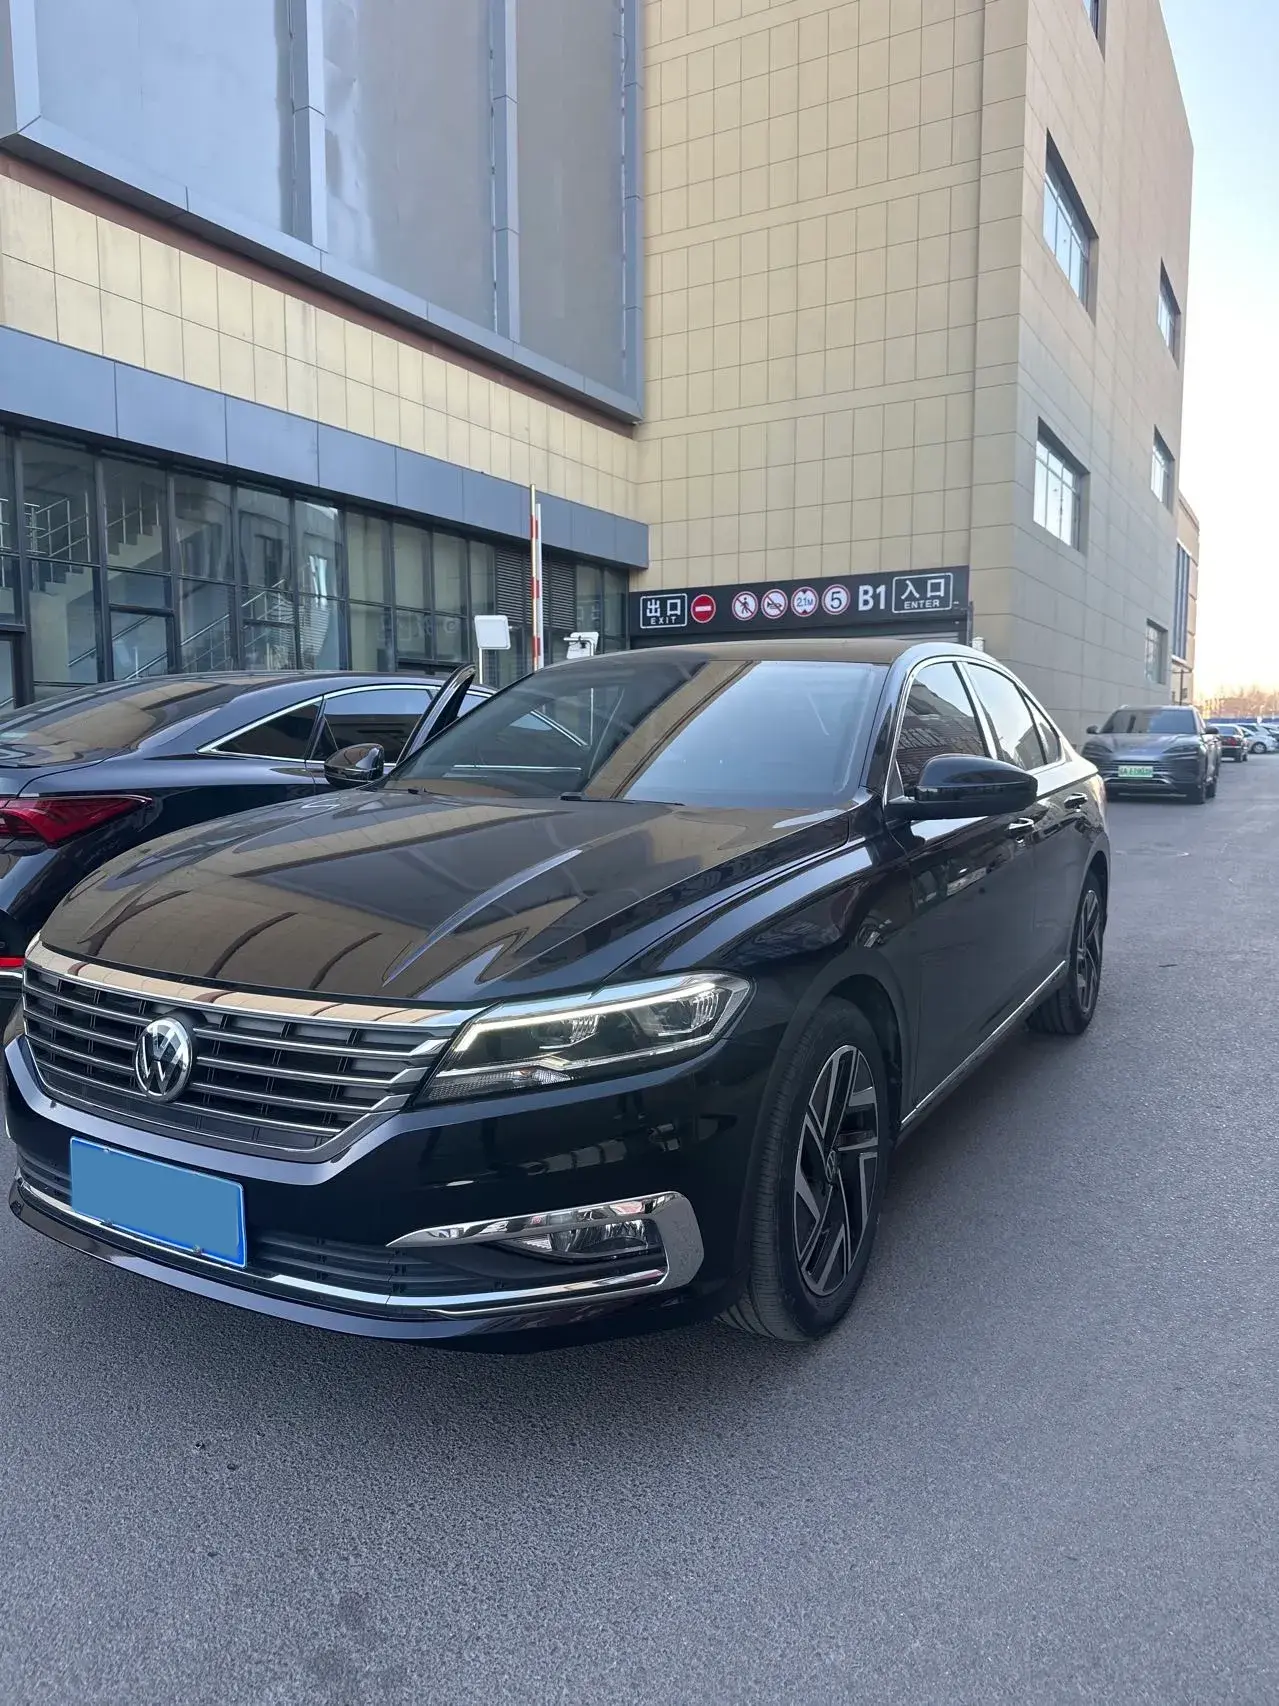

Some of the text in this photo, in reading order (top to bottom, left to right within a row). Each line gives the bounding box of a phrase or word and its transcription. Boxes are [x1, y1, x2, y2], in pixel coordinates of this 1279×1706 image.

[857, 584, 886, 611] B1
[901, 578, 945, 599] 入口
[646, 599, 681, 617] 出口
[830, 590, 842, 609] 5
[904, 599, 940, 609] ENTER
[650, 616, 677, 625] EXIT
